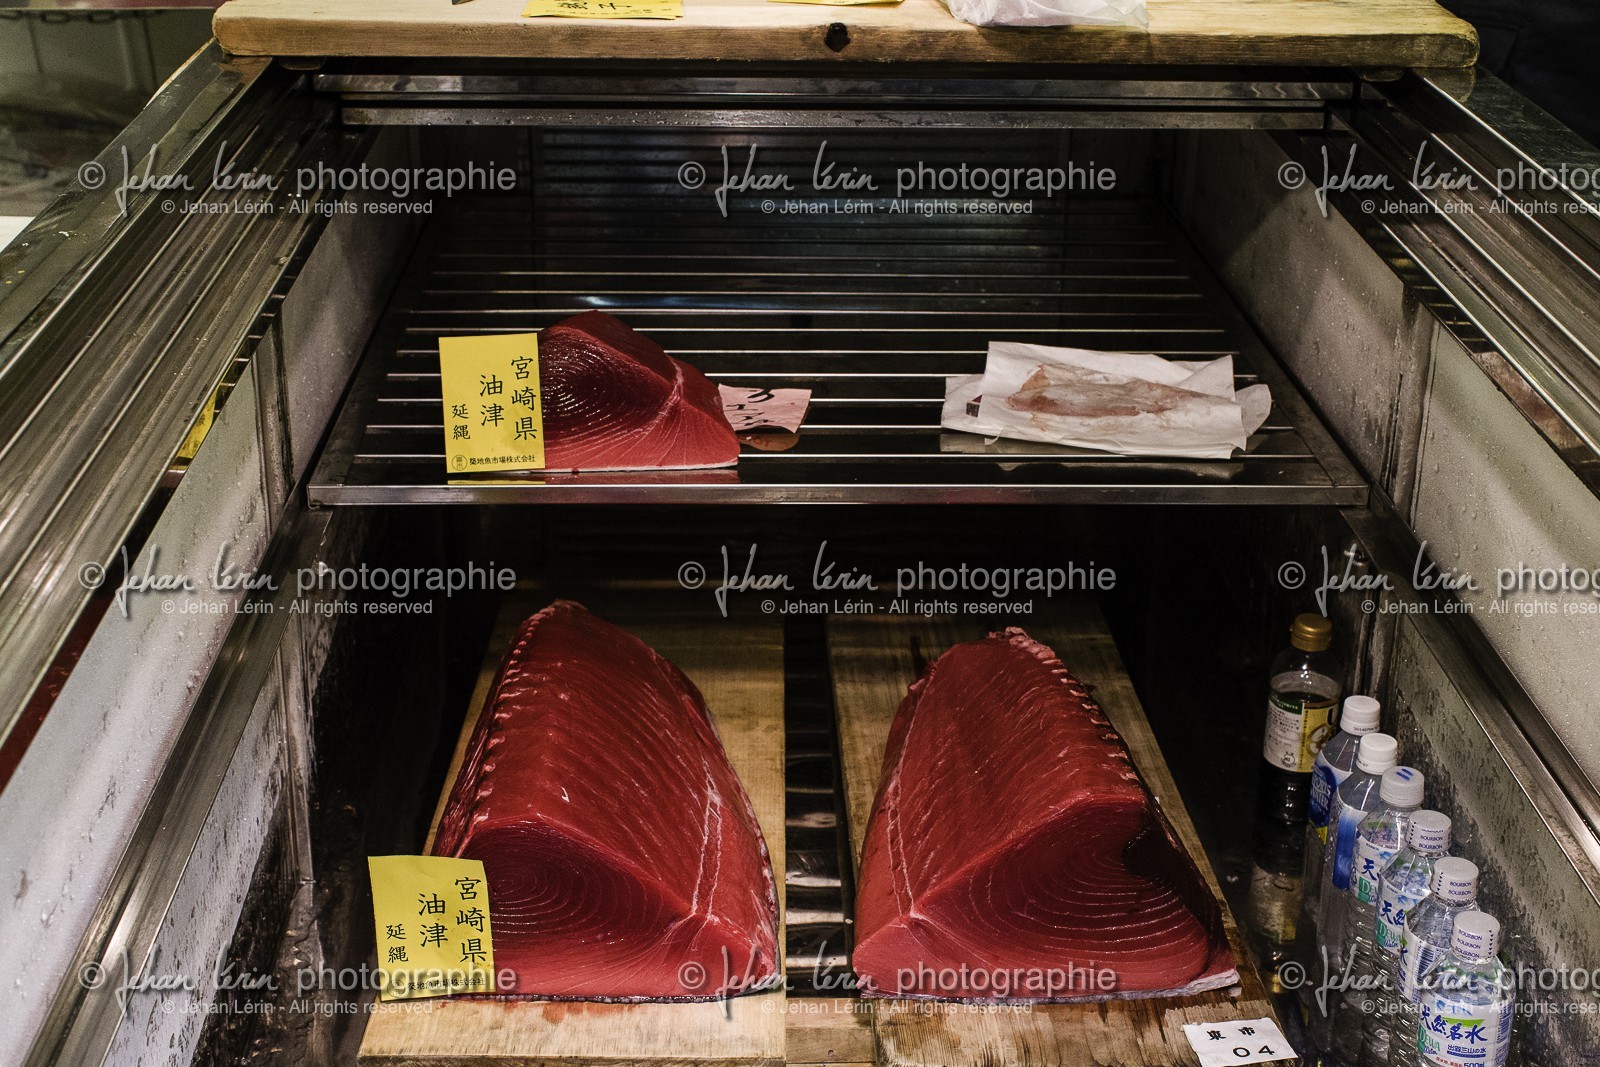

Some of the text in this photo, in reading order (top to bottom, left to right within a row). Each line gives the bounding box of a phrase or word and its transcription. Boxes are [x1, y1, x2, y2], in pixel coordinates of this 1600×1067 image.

[451, 403, 471, 440] 延縄
[479, 374, 505, 428] 油津
[510, 355, 538, 441] 宮崎県
[469, 454, 537, 466] 築地魚市場株式会社
[385, 923, 409, 963] 延縄
[417, 892, 449, 948] 油津
[454, 876, 487, 963] 宮崎県
